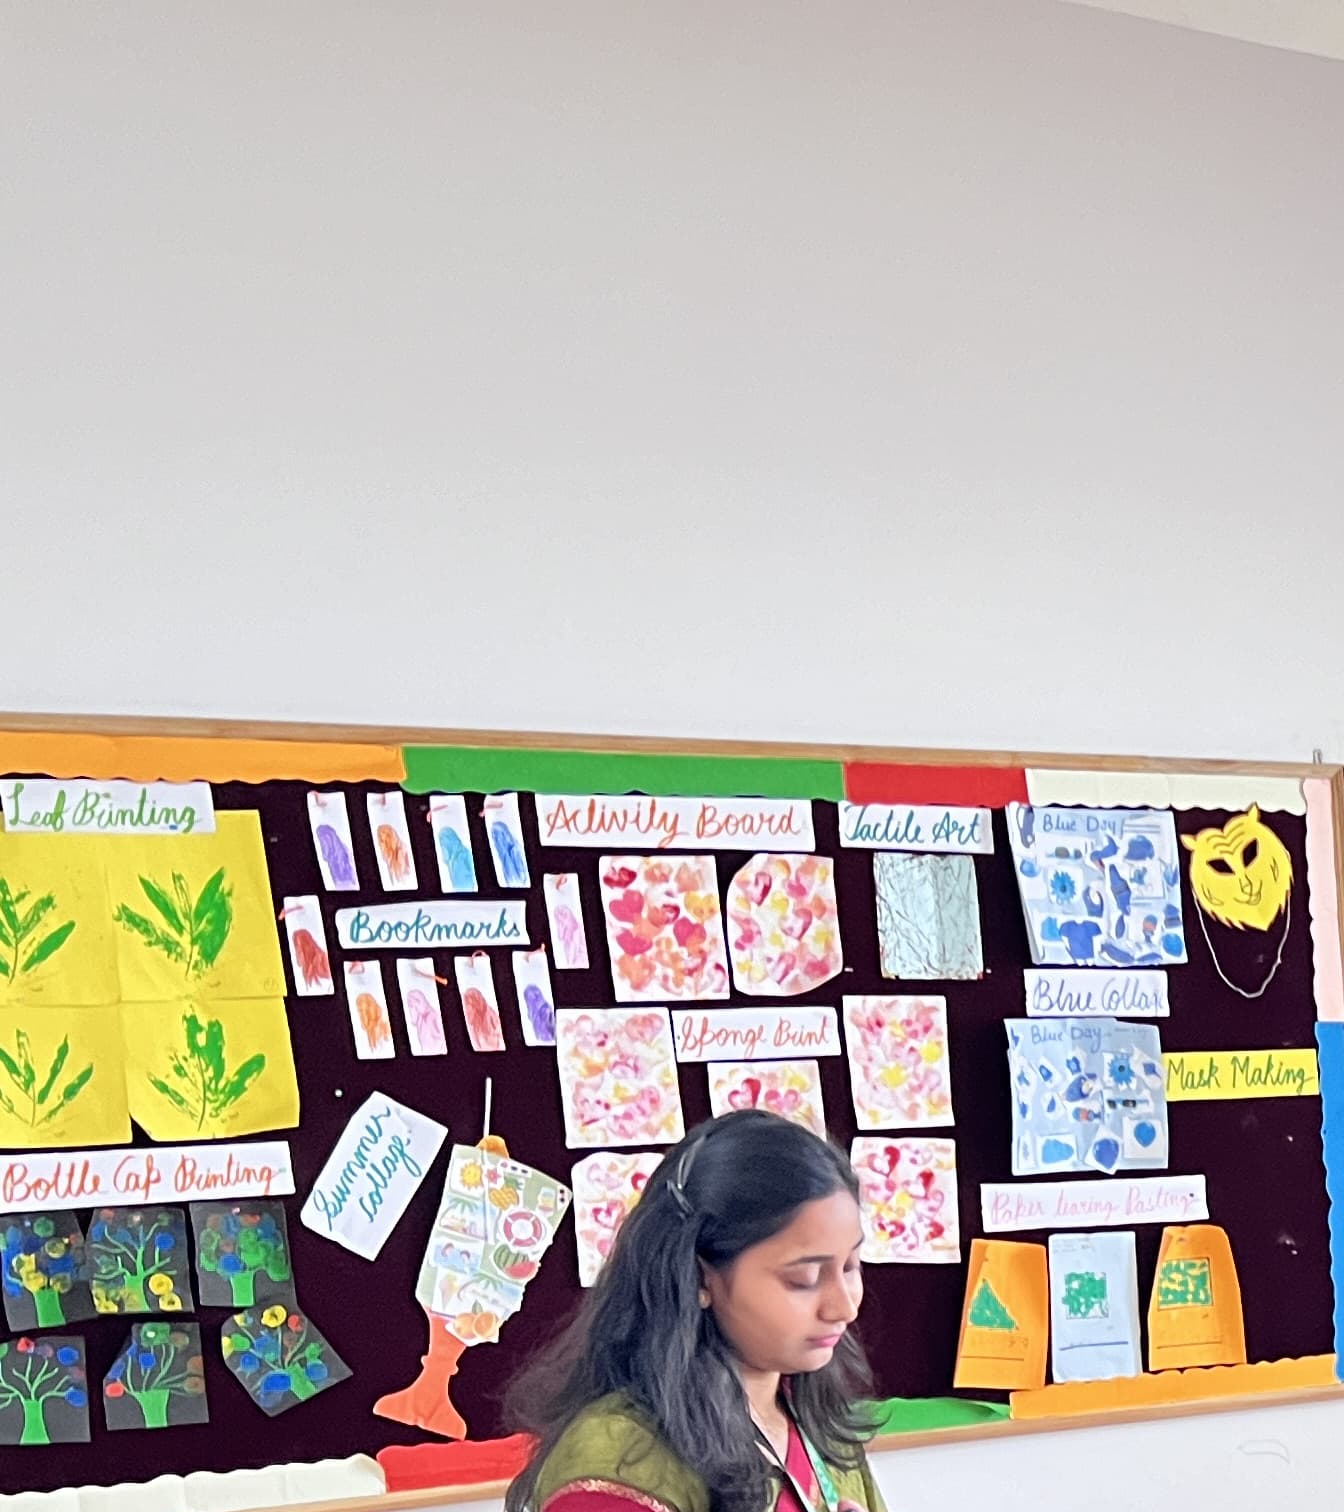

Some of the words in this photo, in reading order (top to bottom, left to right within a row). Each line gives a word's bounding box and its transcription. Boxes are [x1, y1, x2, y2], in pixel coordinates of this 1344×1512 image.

[73, 787, 198, 833] Printing
[546, 798, 688, 847] Activity
[696, 802, 800, 838] Board
[844, 804, 924, 842] Tactile
[932, 811, 980, 844] Art
[1043, 814, 1076, 832] Blue
[1086, 815, 1116, 835] Day
[350, 907, 521, 943] Bookmarks
[1033, 976, 1096, 1012] Blue
[681, 1015, 766, 1059] Sponge
[773, 1015, 829, 1047] Print
[1031, 1025, 1064, 1044] Blue
[1070, 1027, 1102, 1053] Day
[1167, 1057, 1221, 1091] Mask
[1231, 1054, 1315, 1095] Making
[2, 1159, 102, 1203] Bottle
[113, 1154, 162, 1200] Cap
[174, 1153, 278, 1196] Printing
[313, 1105, 392, 1232] Summer
[991, 1190, 1045, 1226] Paper
[1125, 1186, 1198, 1218] Pasting
